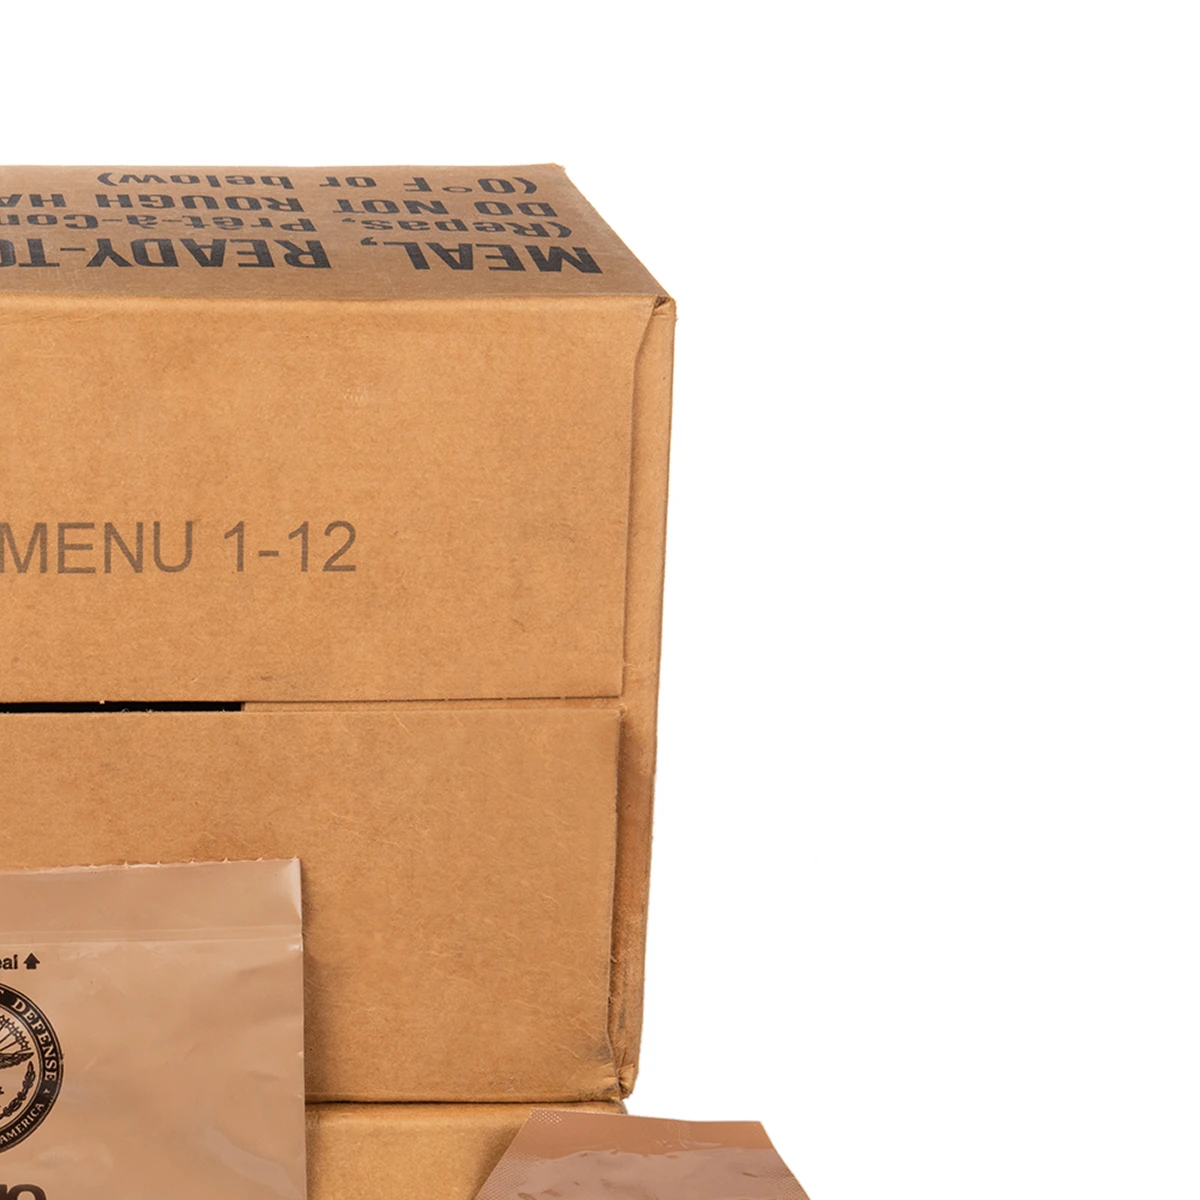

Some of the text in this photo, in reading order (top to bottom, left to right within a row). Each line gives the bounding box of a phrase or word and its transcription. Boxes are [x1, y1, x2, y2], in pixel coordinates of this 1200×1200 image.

[95, 172, 295, 190] below)
[317, 176, 376, 189] or
[94, 194, 304, 212] ROUGH
[333, 199, 449, 215] NOT
[474, 201, 557, 217] DO
[343, 217, 573, 239] (Repas,
[359, 236, 602, 275] MEAL,
[222, 520, 358, 574] 1-12
[10, 998, 58, 1082] DEFENSE
